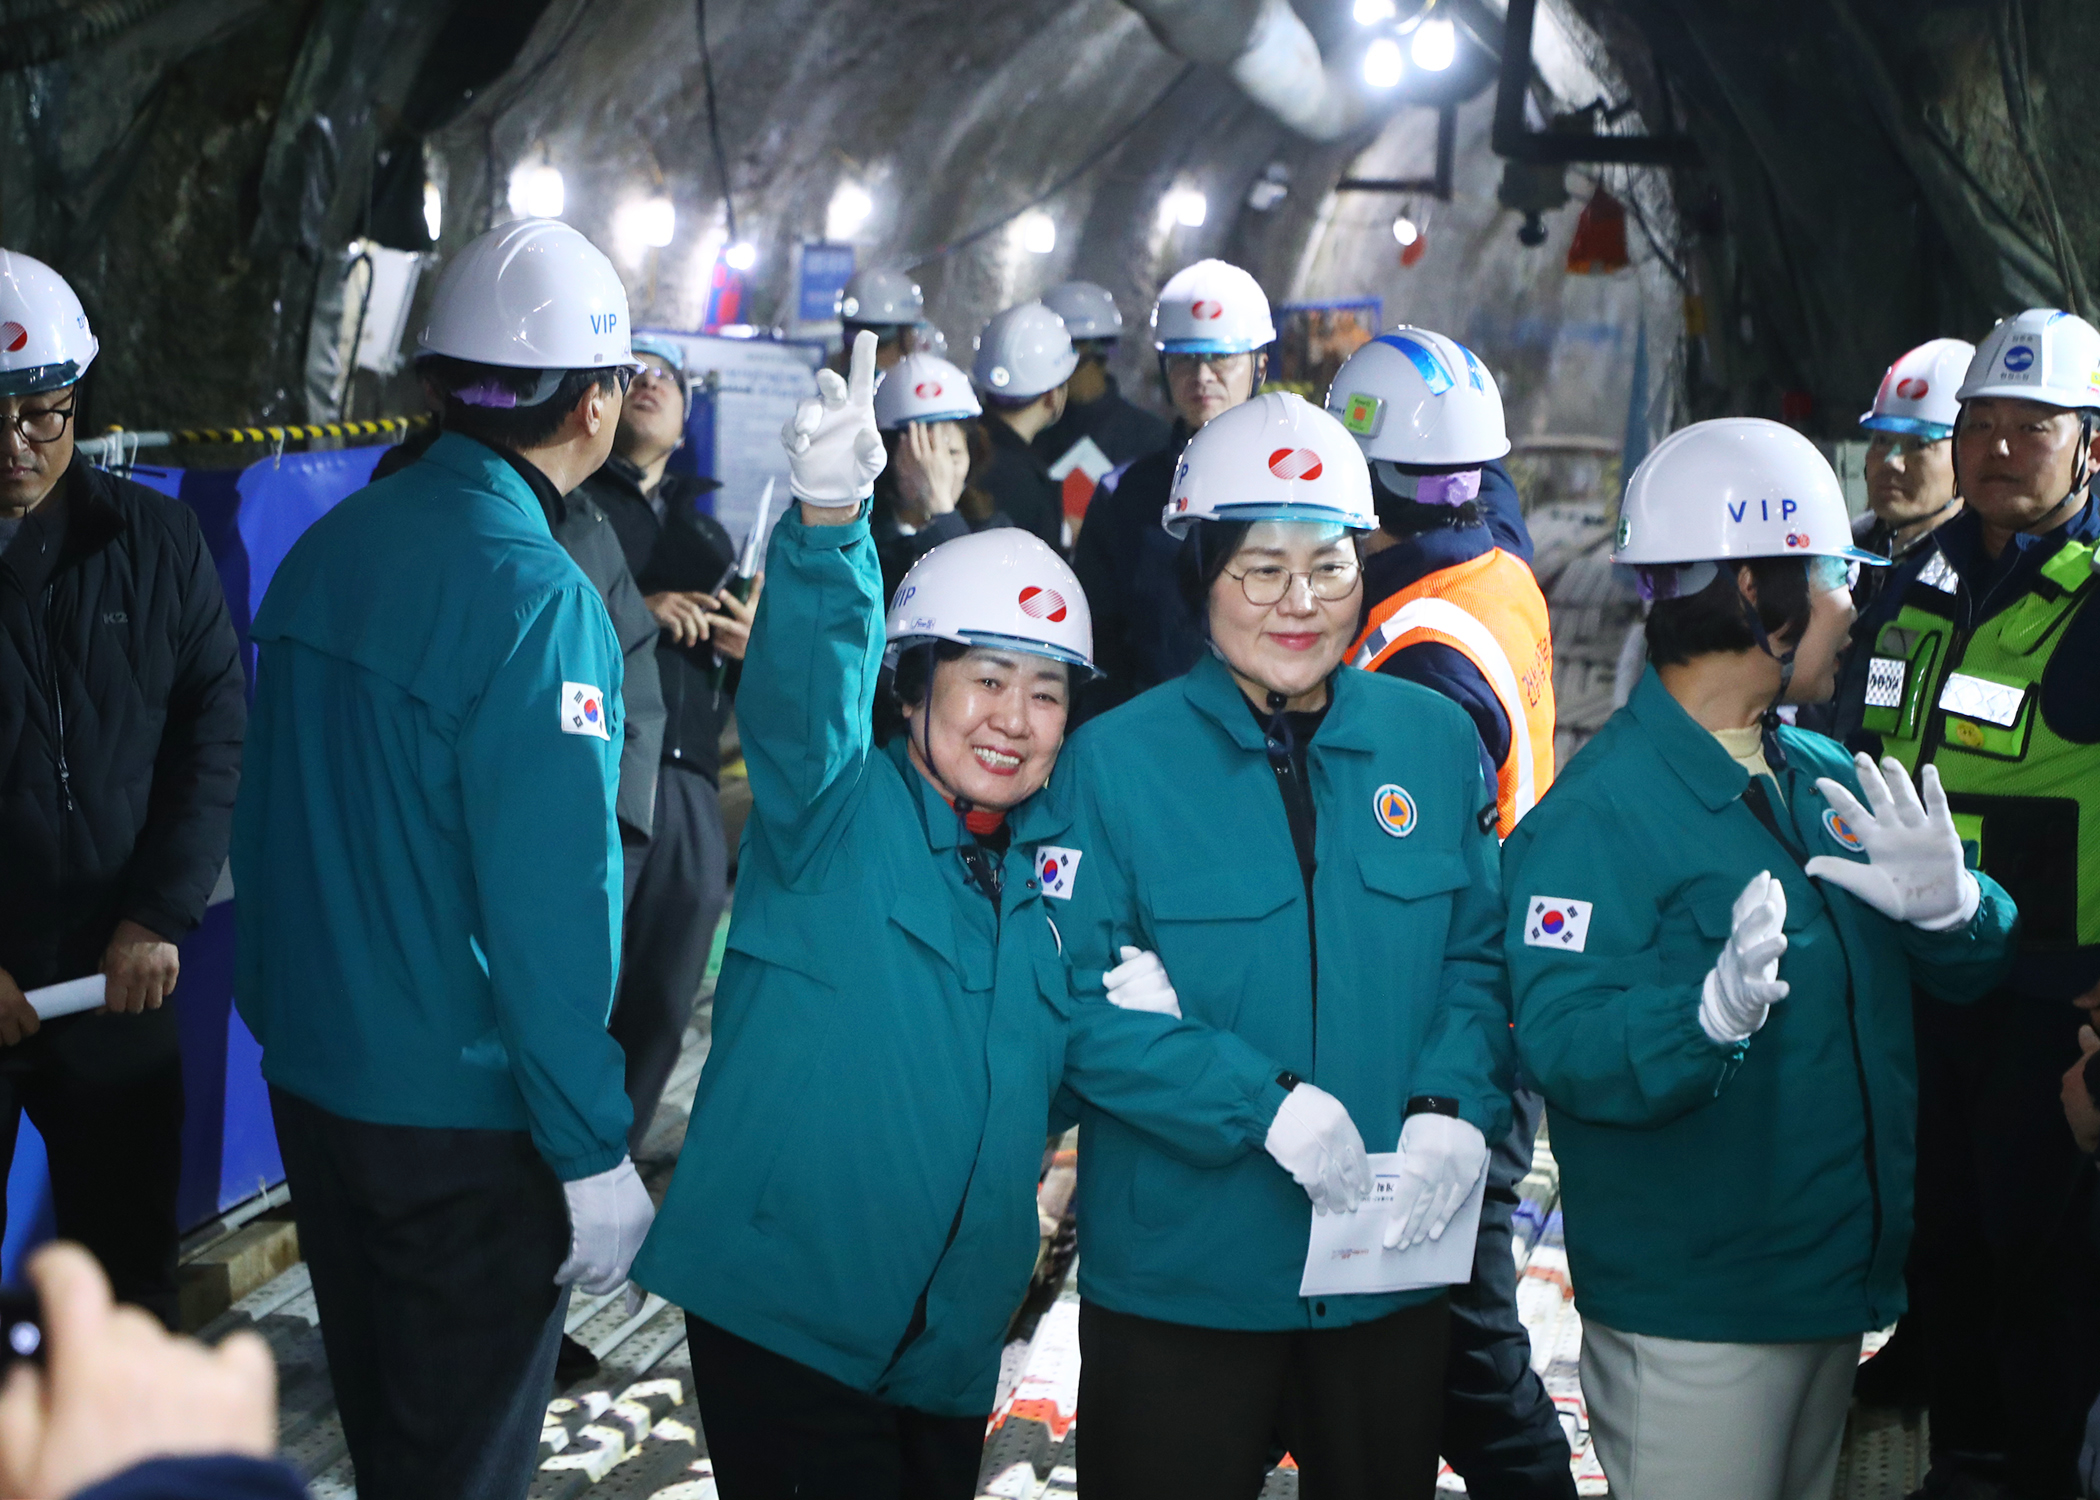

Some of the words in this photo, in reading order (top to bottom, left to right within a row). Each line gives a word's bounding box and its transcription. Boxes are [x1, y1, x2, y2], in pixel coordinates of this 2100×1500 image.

[590, 313, 617, 334] VIP
[1727, 498, 1797, 523] VIP
[893, 586, 916, 610] VIP
[103, 612, 128, 624] K2
